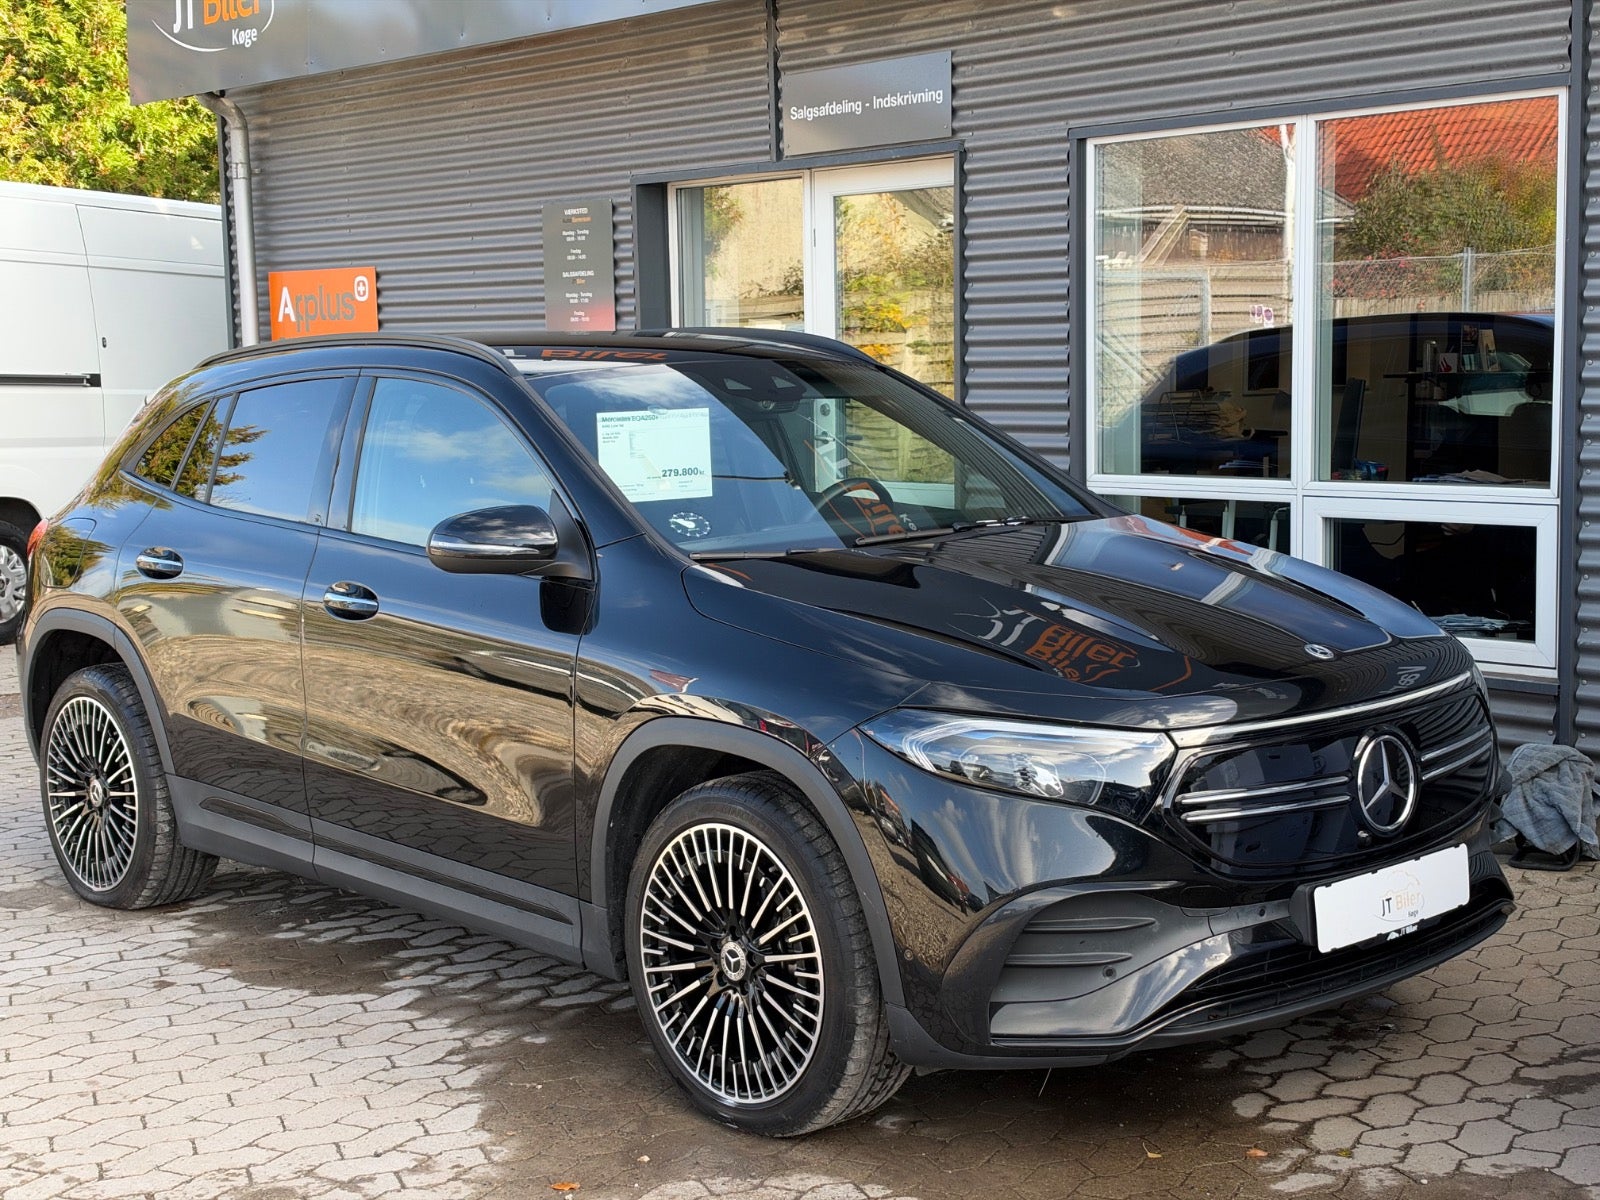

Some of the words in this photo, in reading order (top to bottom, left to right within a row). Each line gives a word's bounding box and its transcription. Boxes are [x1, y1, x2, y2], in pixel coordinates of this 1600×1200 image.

[231, 28, 258, 48] Køge
[790, 100, 862, 121] Salgsafdeling
[873, 88, 944, 109] Indskrivning
[661, 467, 699, 477] 279.800
[1382, 897, 1392, 917] JT
[1396, 891, 1421, 910] Biler
